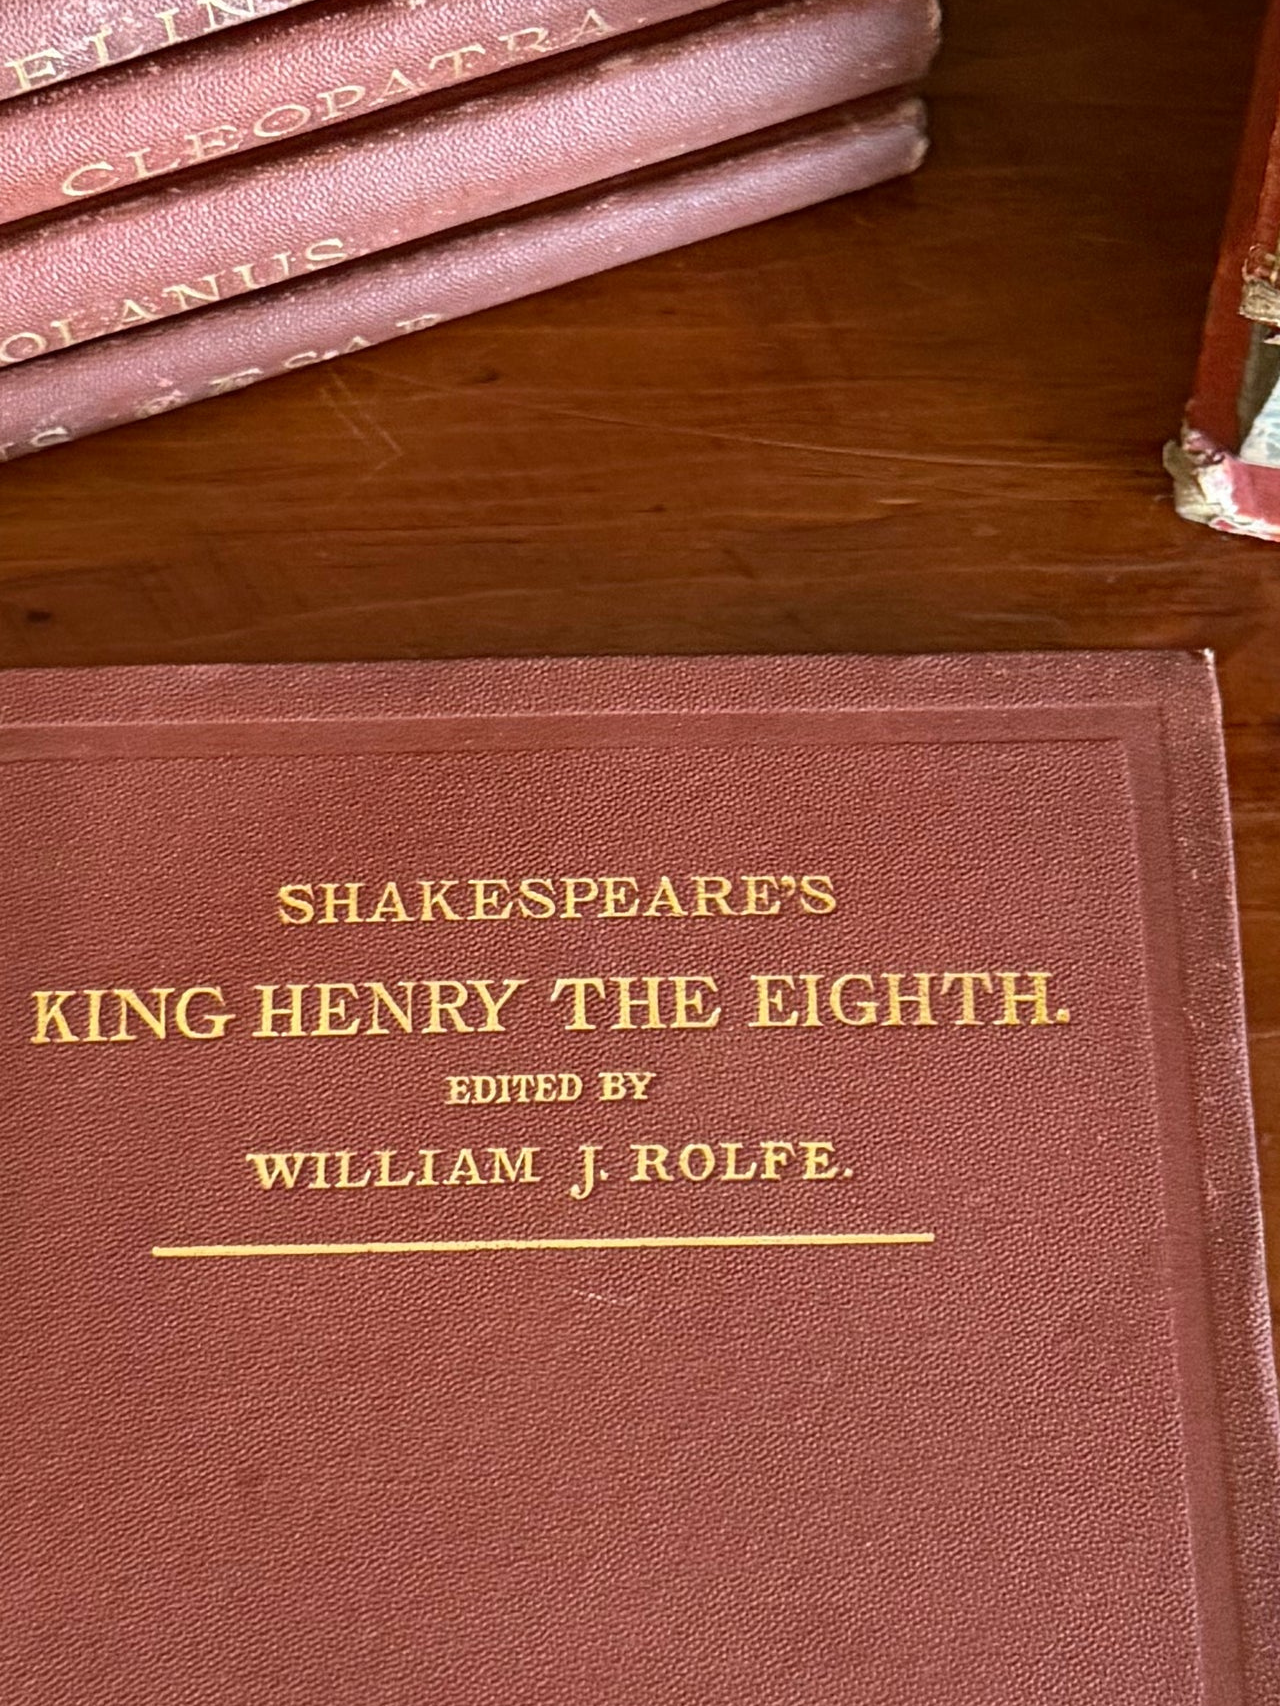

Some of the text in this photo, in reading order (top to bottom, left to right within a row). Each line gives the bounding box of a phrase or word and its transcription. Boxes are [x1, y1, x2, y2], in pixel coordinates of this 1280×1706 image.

[277, 875, 836, 924] SHAKESPEARE'S
[31, 971, 1070, 1045] KING HENRY THE EIGHTH.
[446, 1071, 657, 1106] EDITED BY
[246, 1141, 855, 1200] WILLIAM J. ROLFE.
